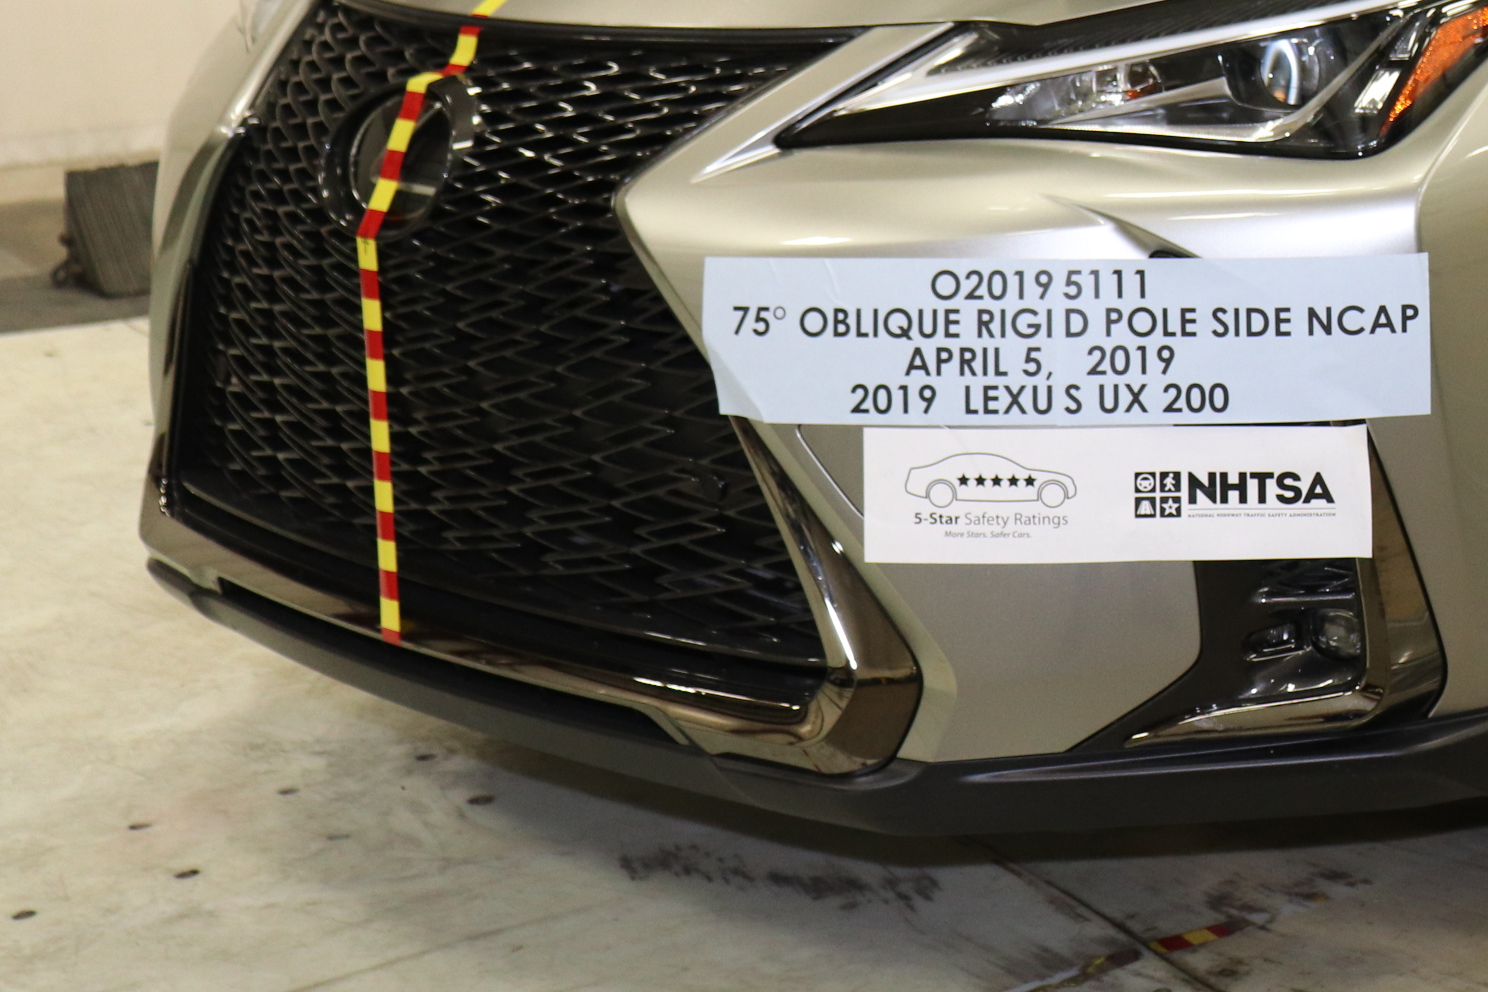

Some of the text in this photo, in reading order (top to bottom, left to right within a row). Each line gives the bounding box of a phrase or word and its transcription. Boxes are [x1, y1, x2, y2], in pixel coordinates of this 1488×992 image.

[732, 304, 1419, 341] 75° OBLIQUE RIGID POLE SIDE NCAP
[904, 345, 1175, 381] APRIL 5, 2019
[850, 383, 1229, 415] 2019 LEXUS UX 200
[1187, 471, 1335, 505] NHTSA
[913, 511, 1068, 529] 5-Star Safety Ratings
[944, 530, 1032, 538] More Stars. Safer Cars.
